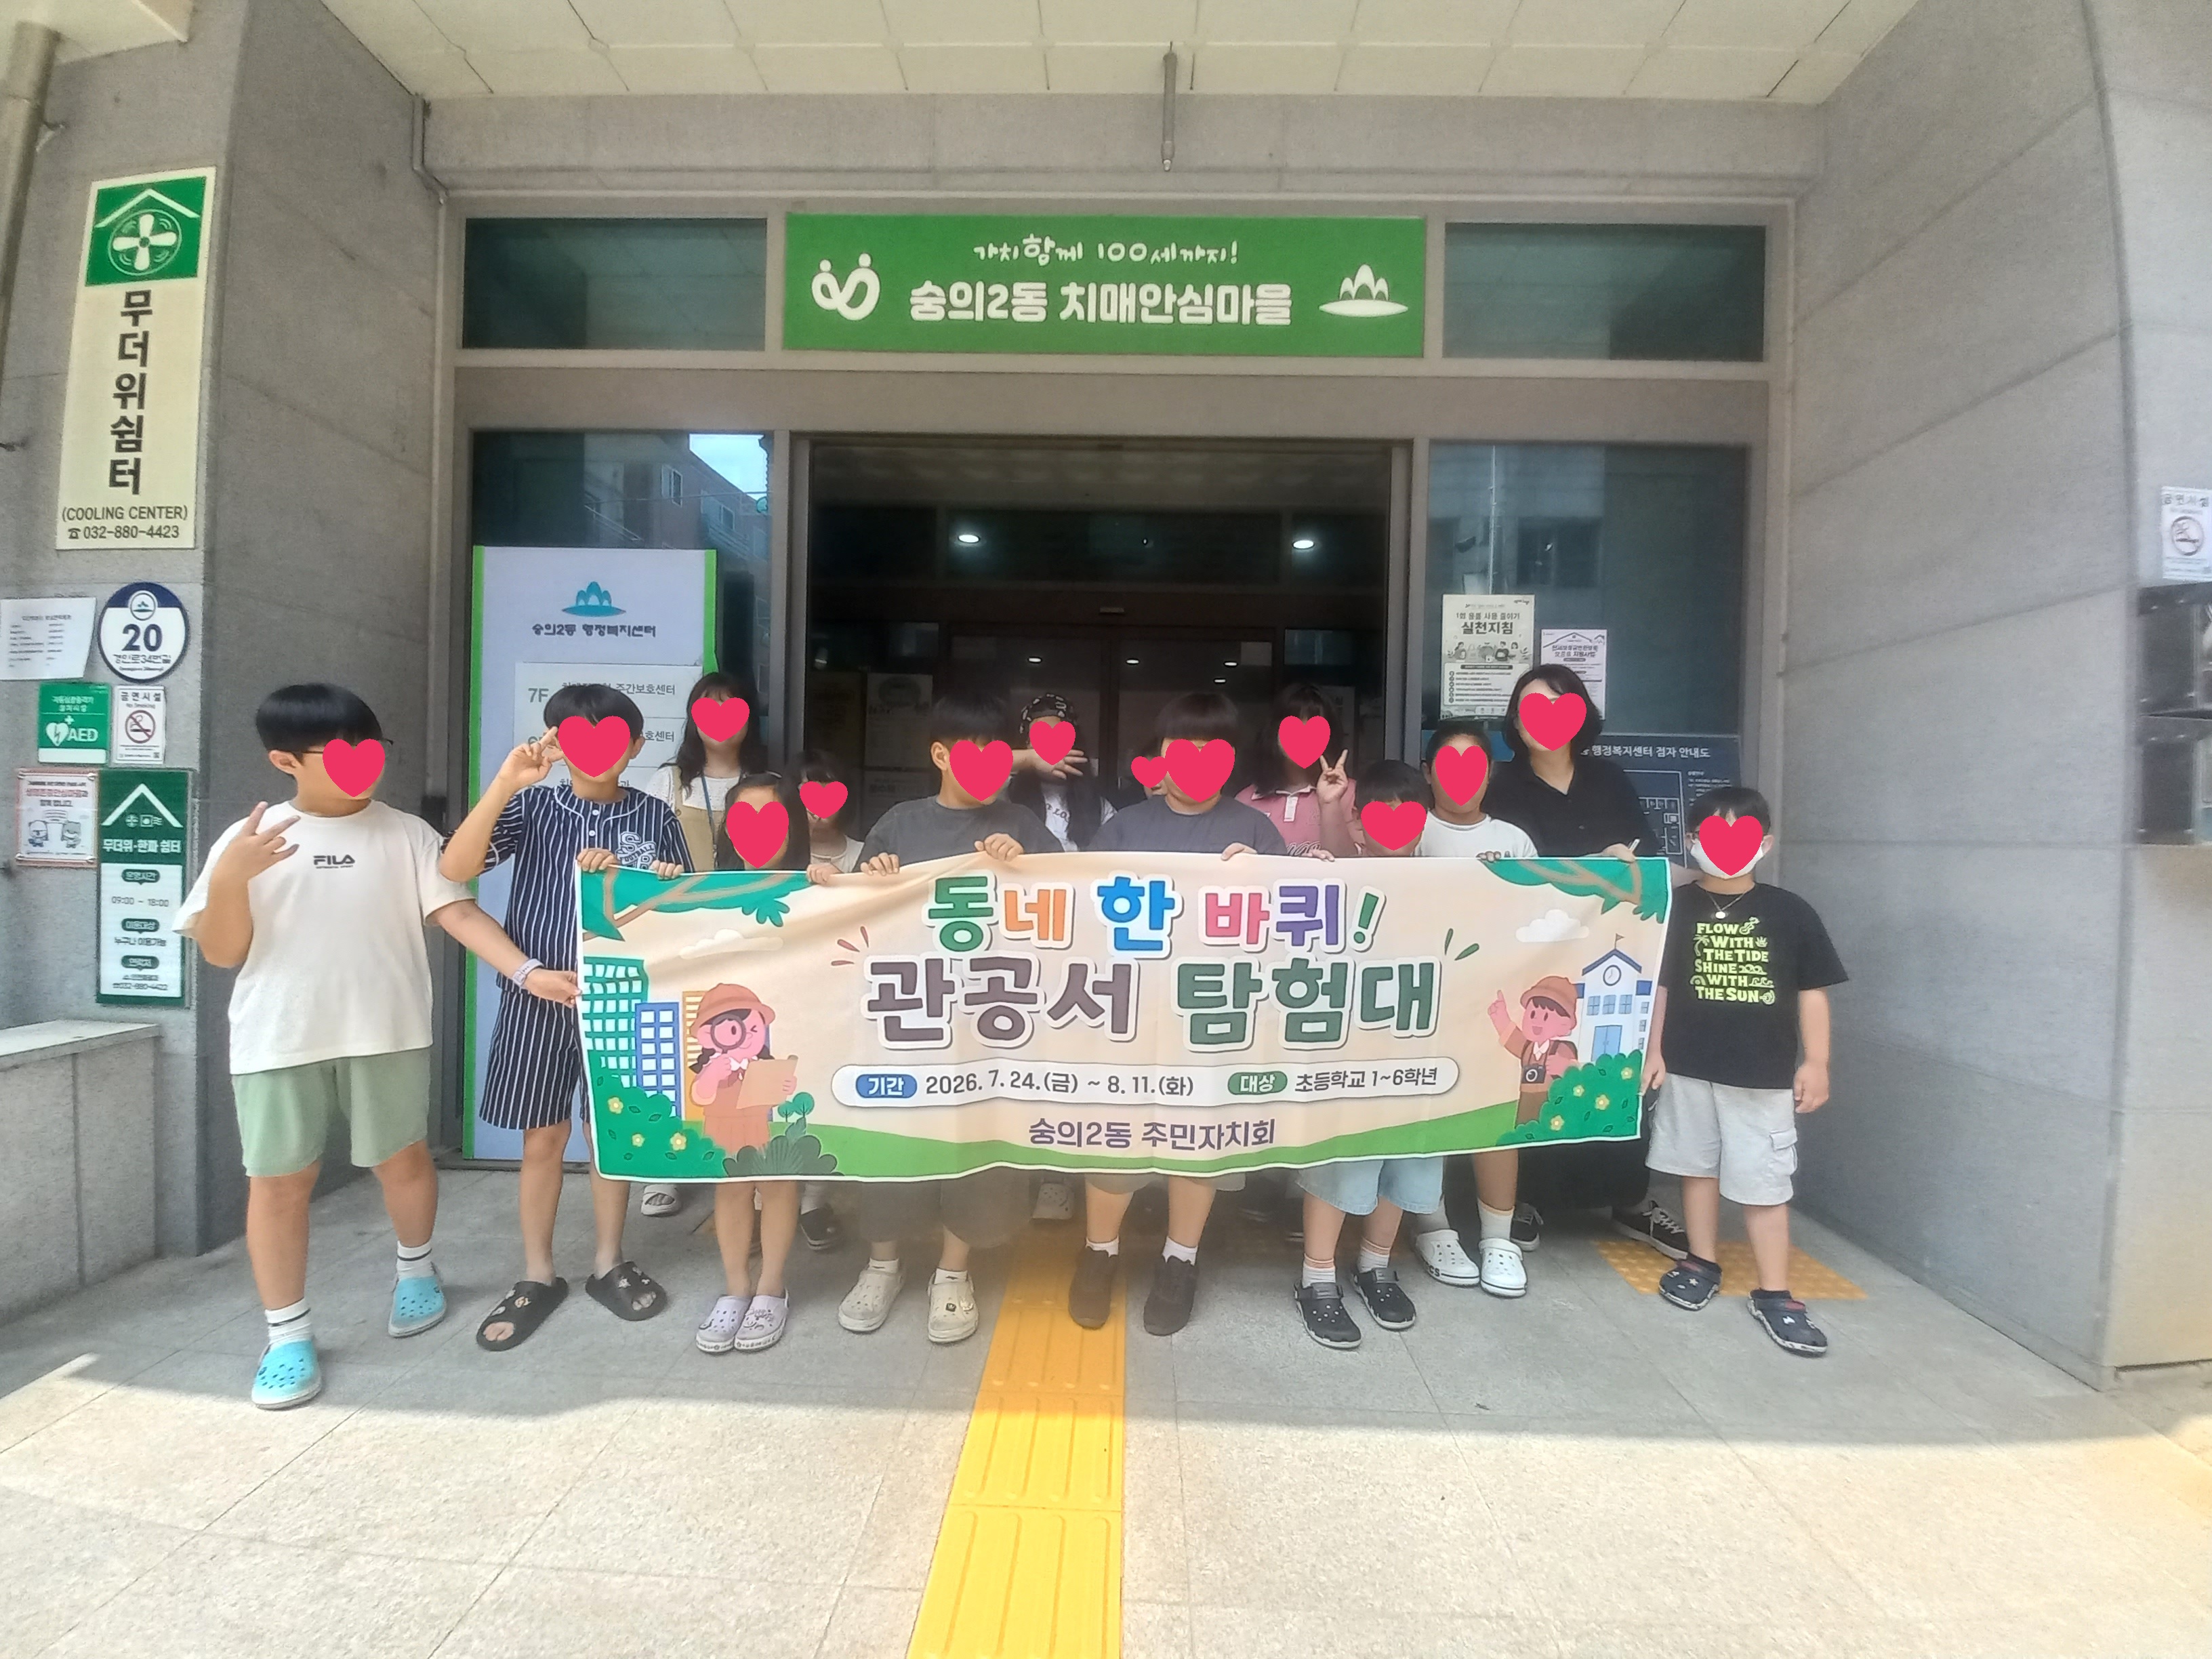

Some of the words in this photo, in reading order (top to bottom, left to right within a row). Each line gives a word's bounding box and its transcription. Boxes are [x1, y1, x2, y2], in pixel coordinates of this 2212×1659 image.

[973, 232, 1084, 266] 가치함께
[1097, 240, 1238, 264] 100세까지!
[909, 280, 1048, 323] 숭의2동
[1059, 281, 1292, 325] 치매안심마을
[62, 506, 125, 522] (COOLING
[128, 505, 188, 520] CENTER)
[83, 525, 180, 539] 032-880-4423
[532, 623, 576, 636] 숭의2동
[582, 623, 656, 638] 행정복지센터
[1461, 621, 1513, 634] 실천지침
[121, 623, 163, 651] 20
[528, 687, 549, 703] 7F
[616, 683, 676, 695] 주간보호센터
[66, 728, 99, 742] AED
[644, 731, 675, 743] 호센터
[1591, 745, 1653, 757] 행정복지센터
[1679, 747, 1711, 759] 안내도
[313, 855, 356, 865] FILA
[927, 876, 1068, 952] 동네
[1097, 875, 1176, 951] 한
[1204, 884, 1380, 947] 바퀴!
[1696, 922, 1740, 935] FLOW
[1711, 935, 1754, 949] WITH
[1703, 948, 1733, 961] THE
[1734, 949, 1769, 962] TIDE
[1694, 958, 1738, 974] SHINE
[1706, 974, 1748, 987] WITH
[867, 955, 1132, 1042] 관공서
[1176, 956, 1435, 1045] 탐험대
[1695, 985, 1725, 1001] THE
[1725, 987, 1760, 1003] SUN
[867, 1076, 905, 1097] 기간
[1240, 1073, 1277, 1093] 대상
[1294, 1069, 1366, 1094] 초등학교
[1372, 1067, 1437, 1086] 1~6학년
[1028, 1117, 1132, 1149] 숭의2동
[1141, 1118, 1275, 1151] 주민자치회
